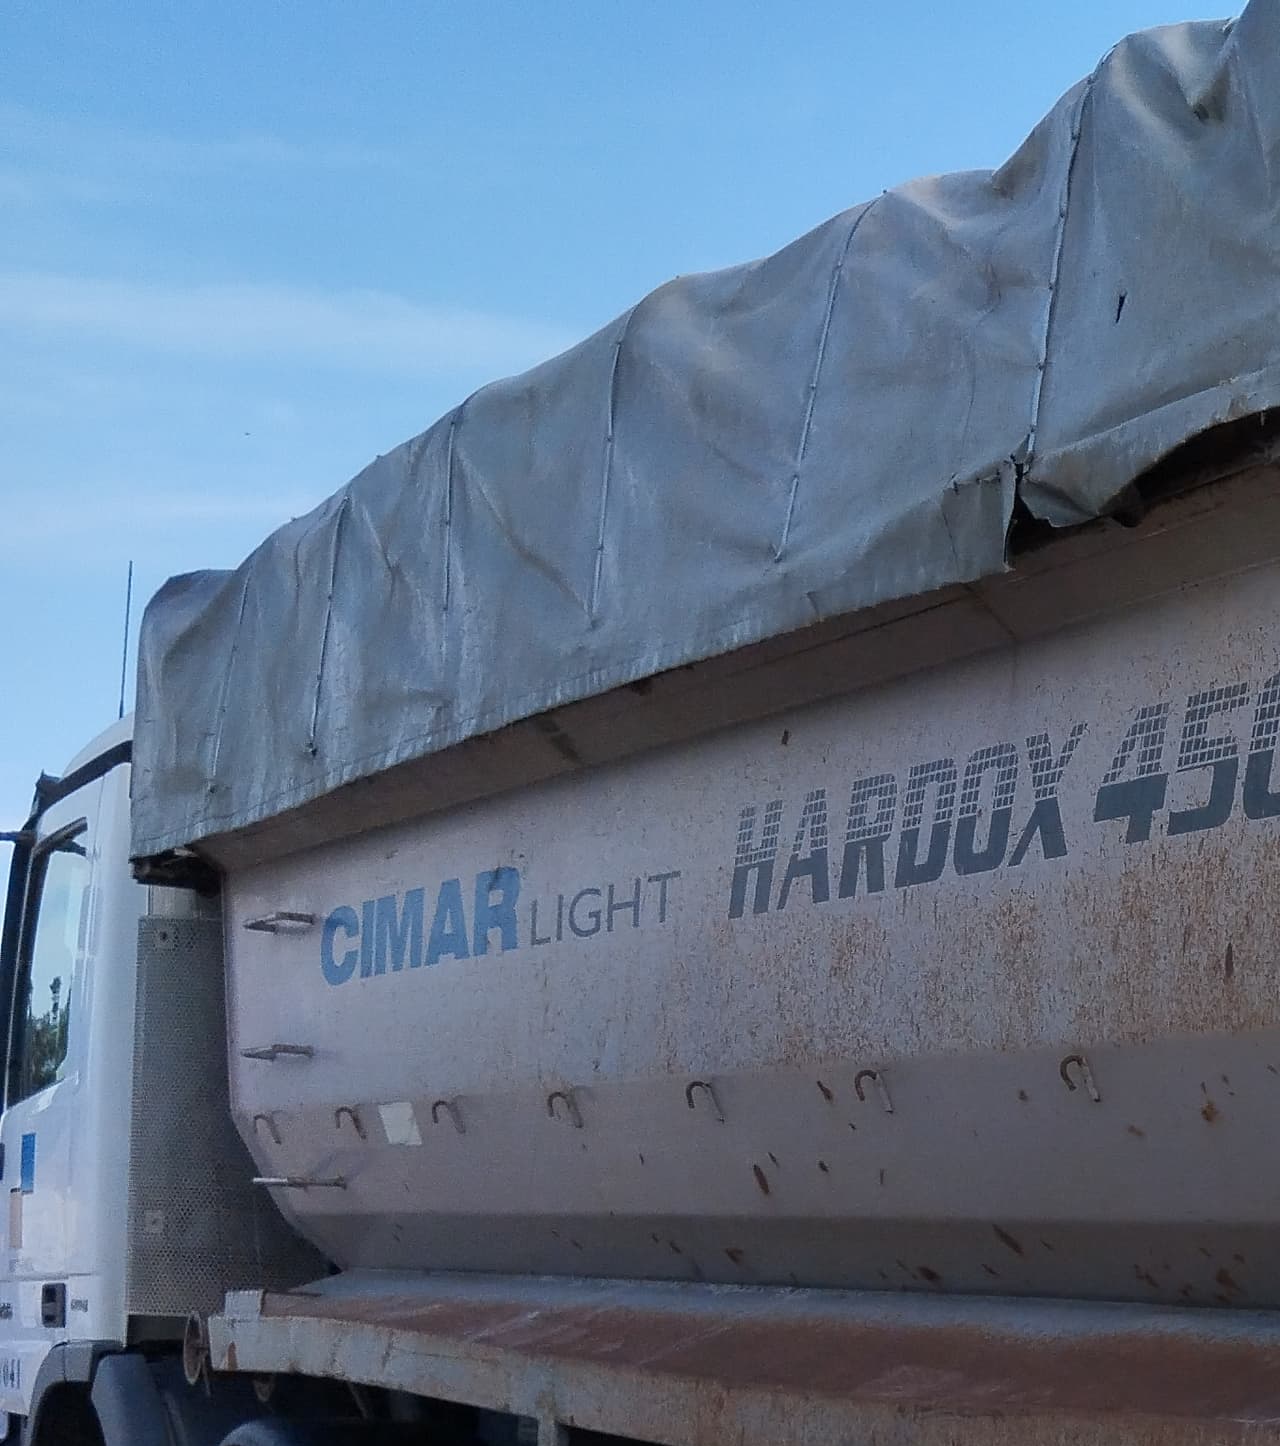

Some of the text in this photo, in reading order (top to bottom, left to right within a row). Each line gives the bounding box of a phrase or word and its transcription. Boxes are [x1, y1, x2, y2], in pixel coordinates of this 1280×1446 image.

[728, 722, 1089, 920] HARDOX
[320, 866, 682, 987] CIMAR LIGHT
